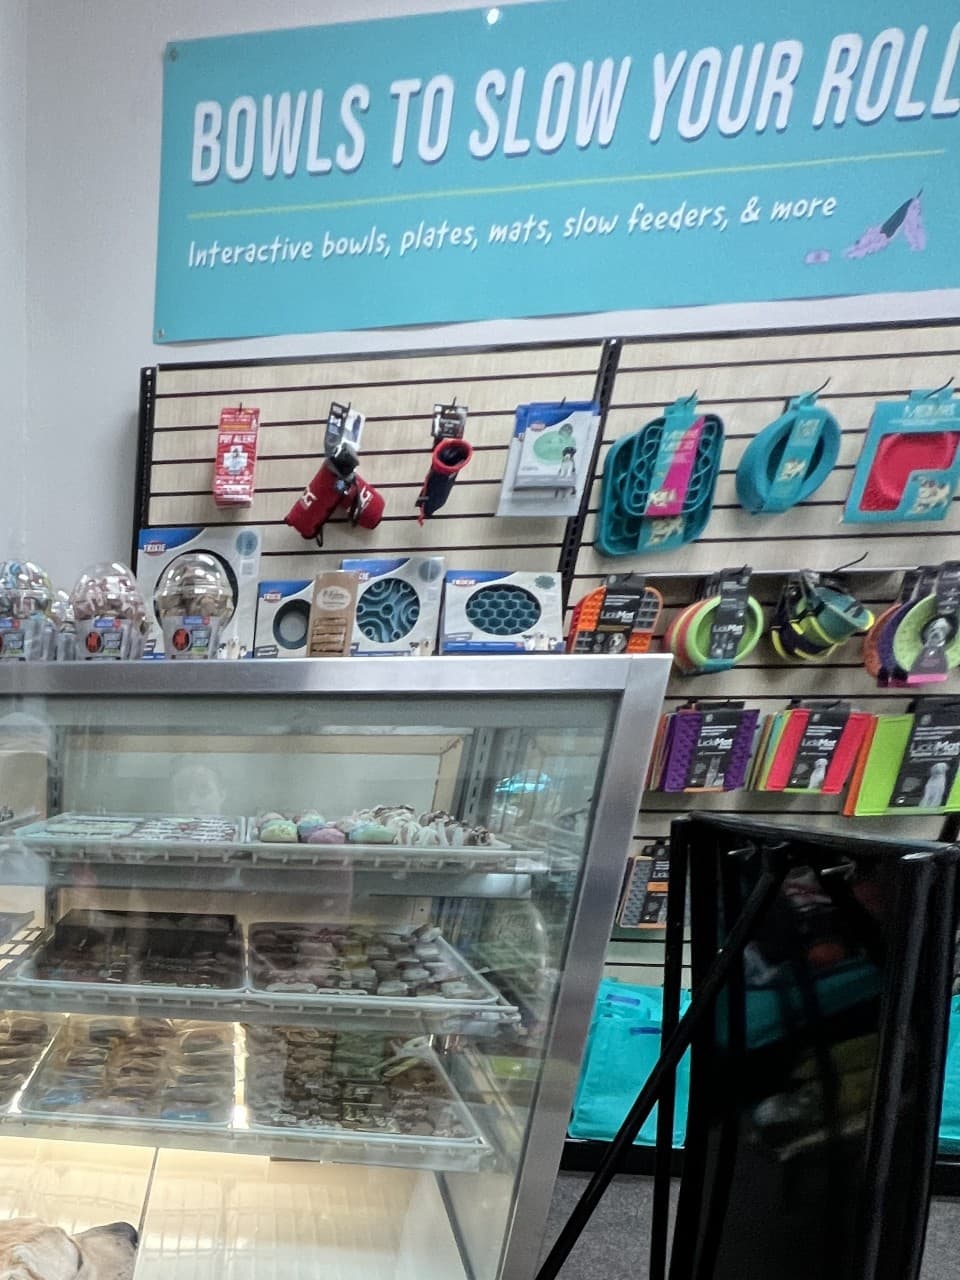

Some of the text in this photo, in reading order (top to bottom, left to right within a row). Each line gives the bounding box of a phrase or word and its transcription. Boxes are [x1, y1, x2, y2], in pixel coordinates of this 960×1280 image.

[191, 20, 960, 184] BOWLS TO SLOW YOUR ROLL
[188, 195, 838, 268] Interactive bowls, plates, mats, slow feeders, & more
